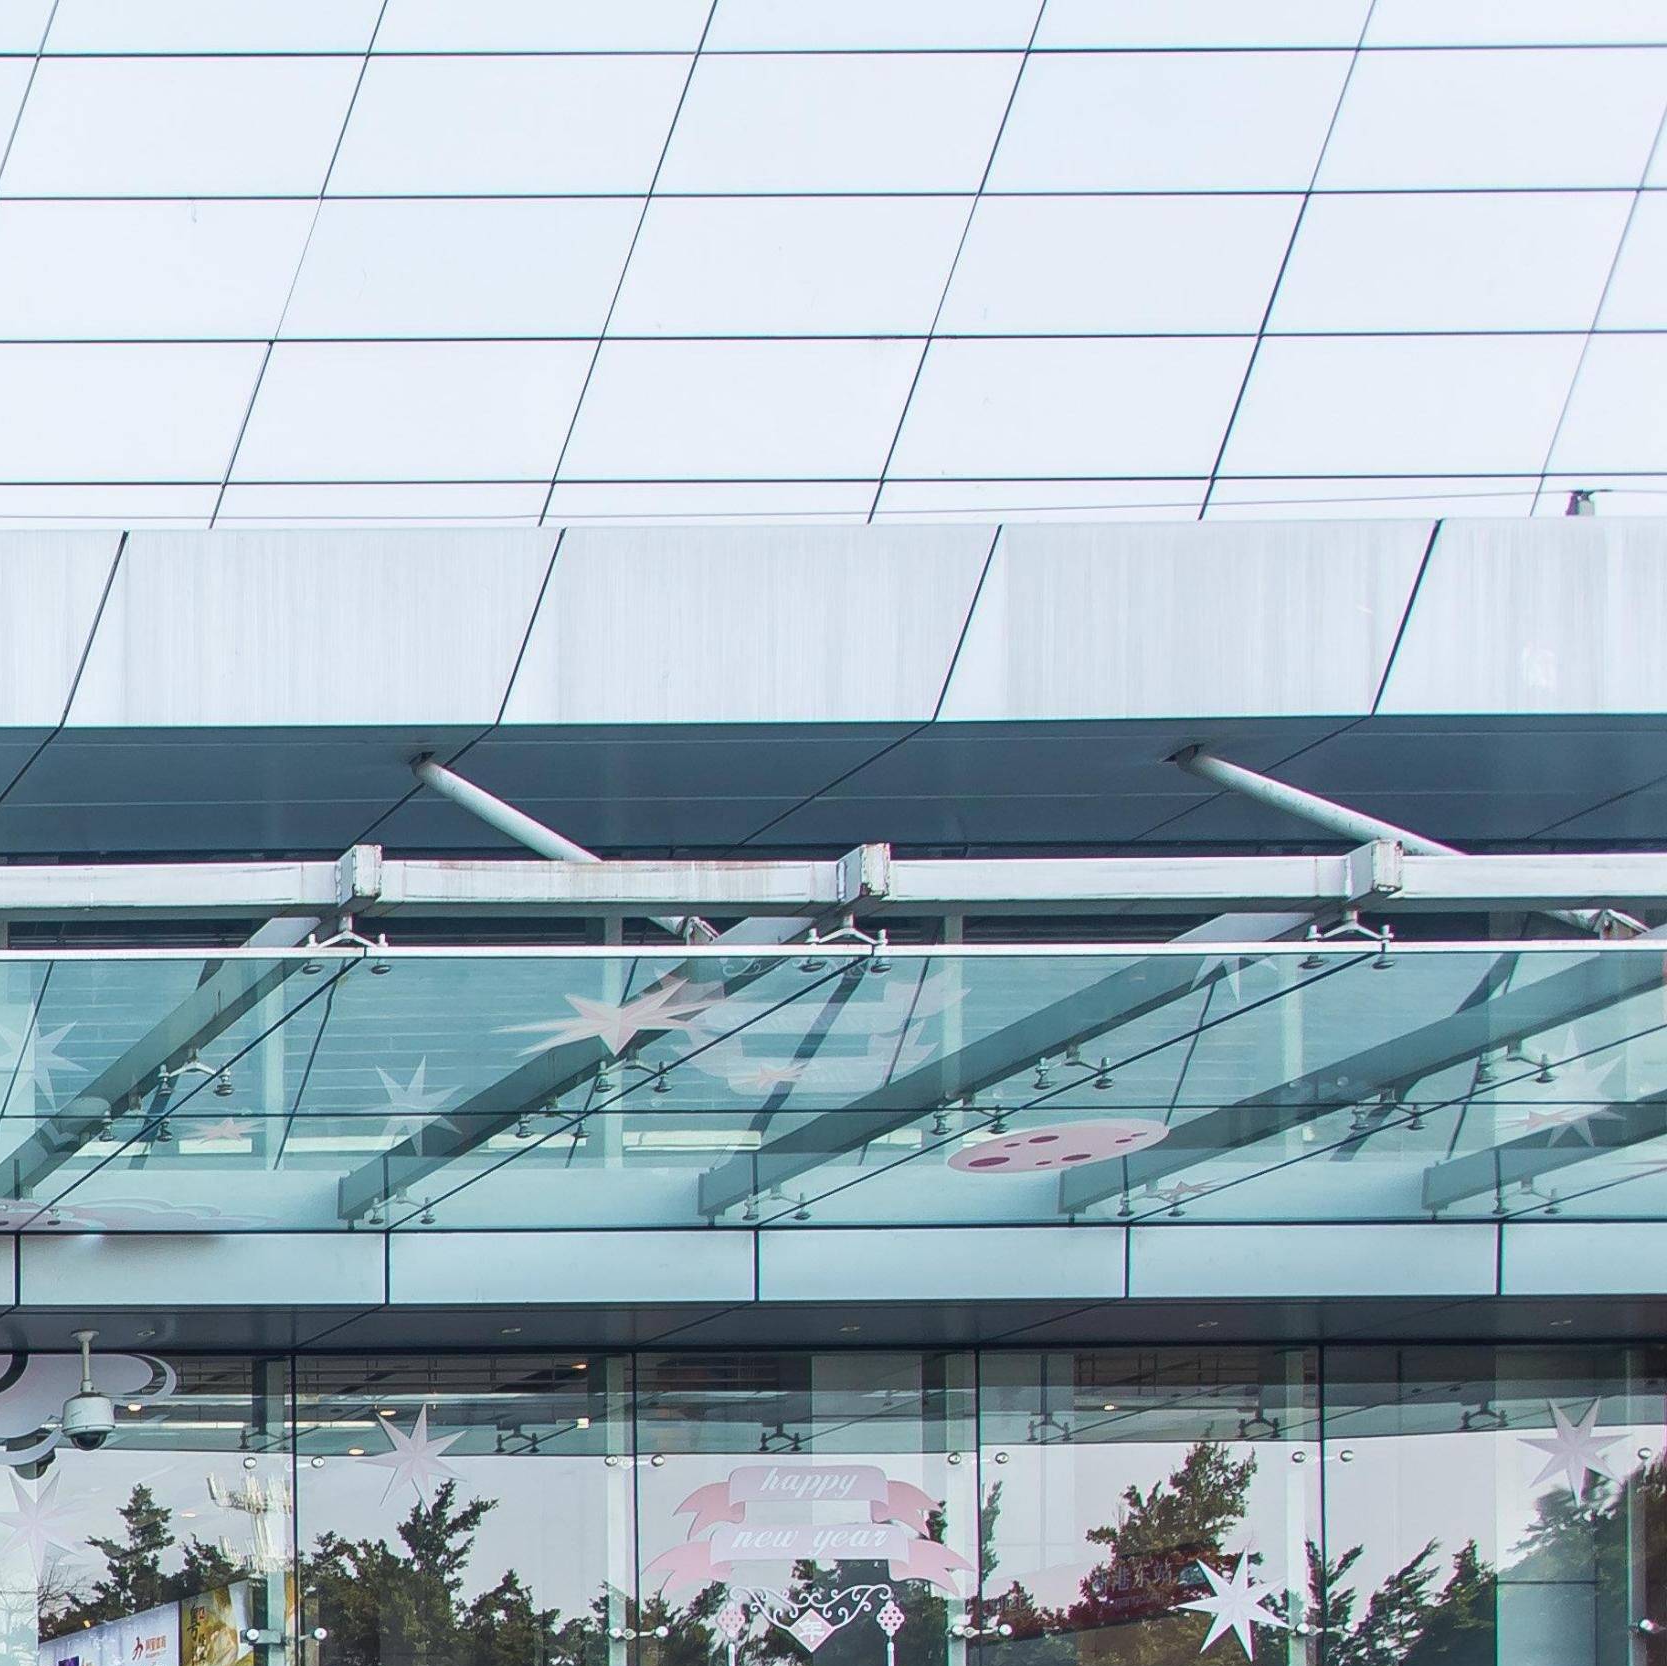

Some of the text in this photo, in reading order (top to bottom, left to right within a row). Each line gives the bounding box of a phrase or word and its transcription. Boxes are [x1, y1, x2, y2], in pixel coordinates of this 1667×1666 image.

[760, 1467, 858, 1498] happy
[731, 1529, 892, 1557] new year
[799, 1620, 825, 1641] 年
